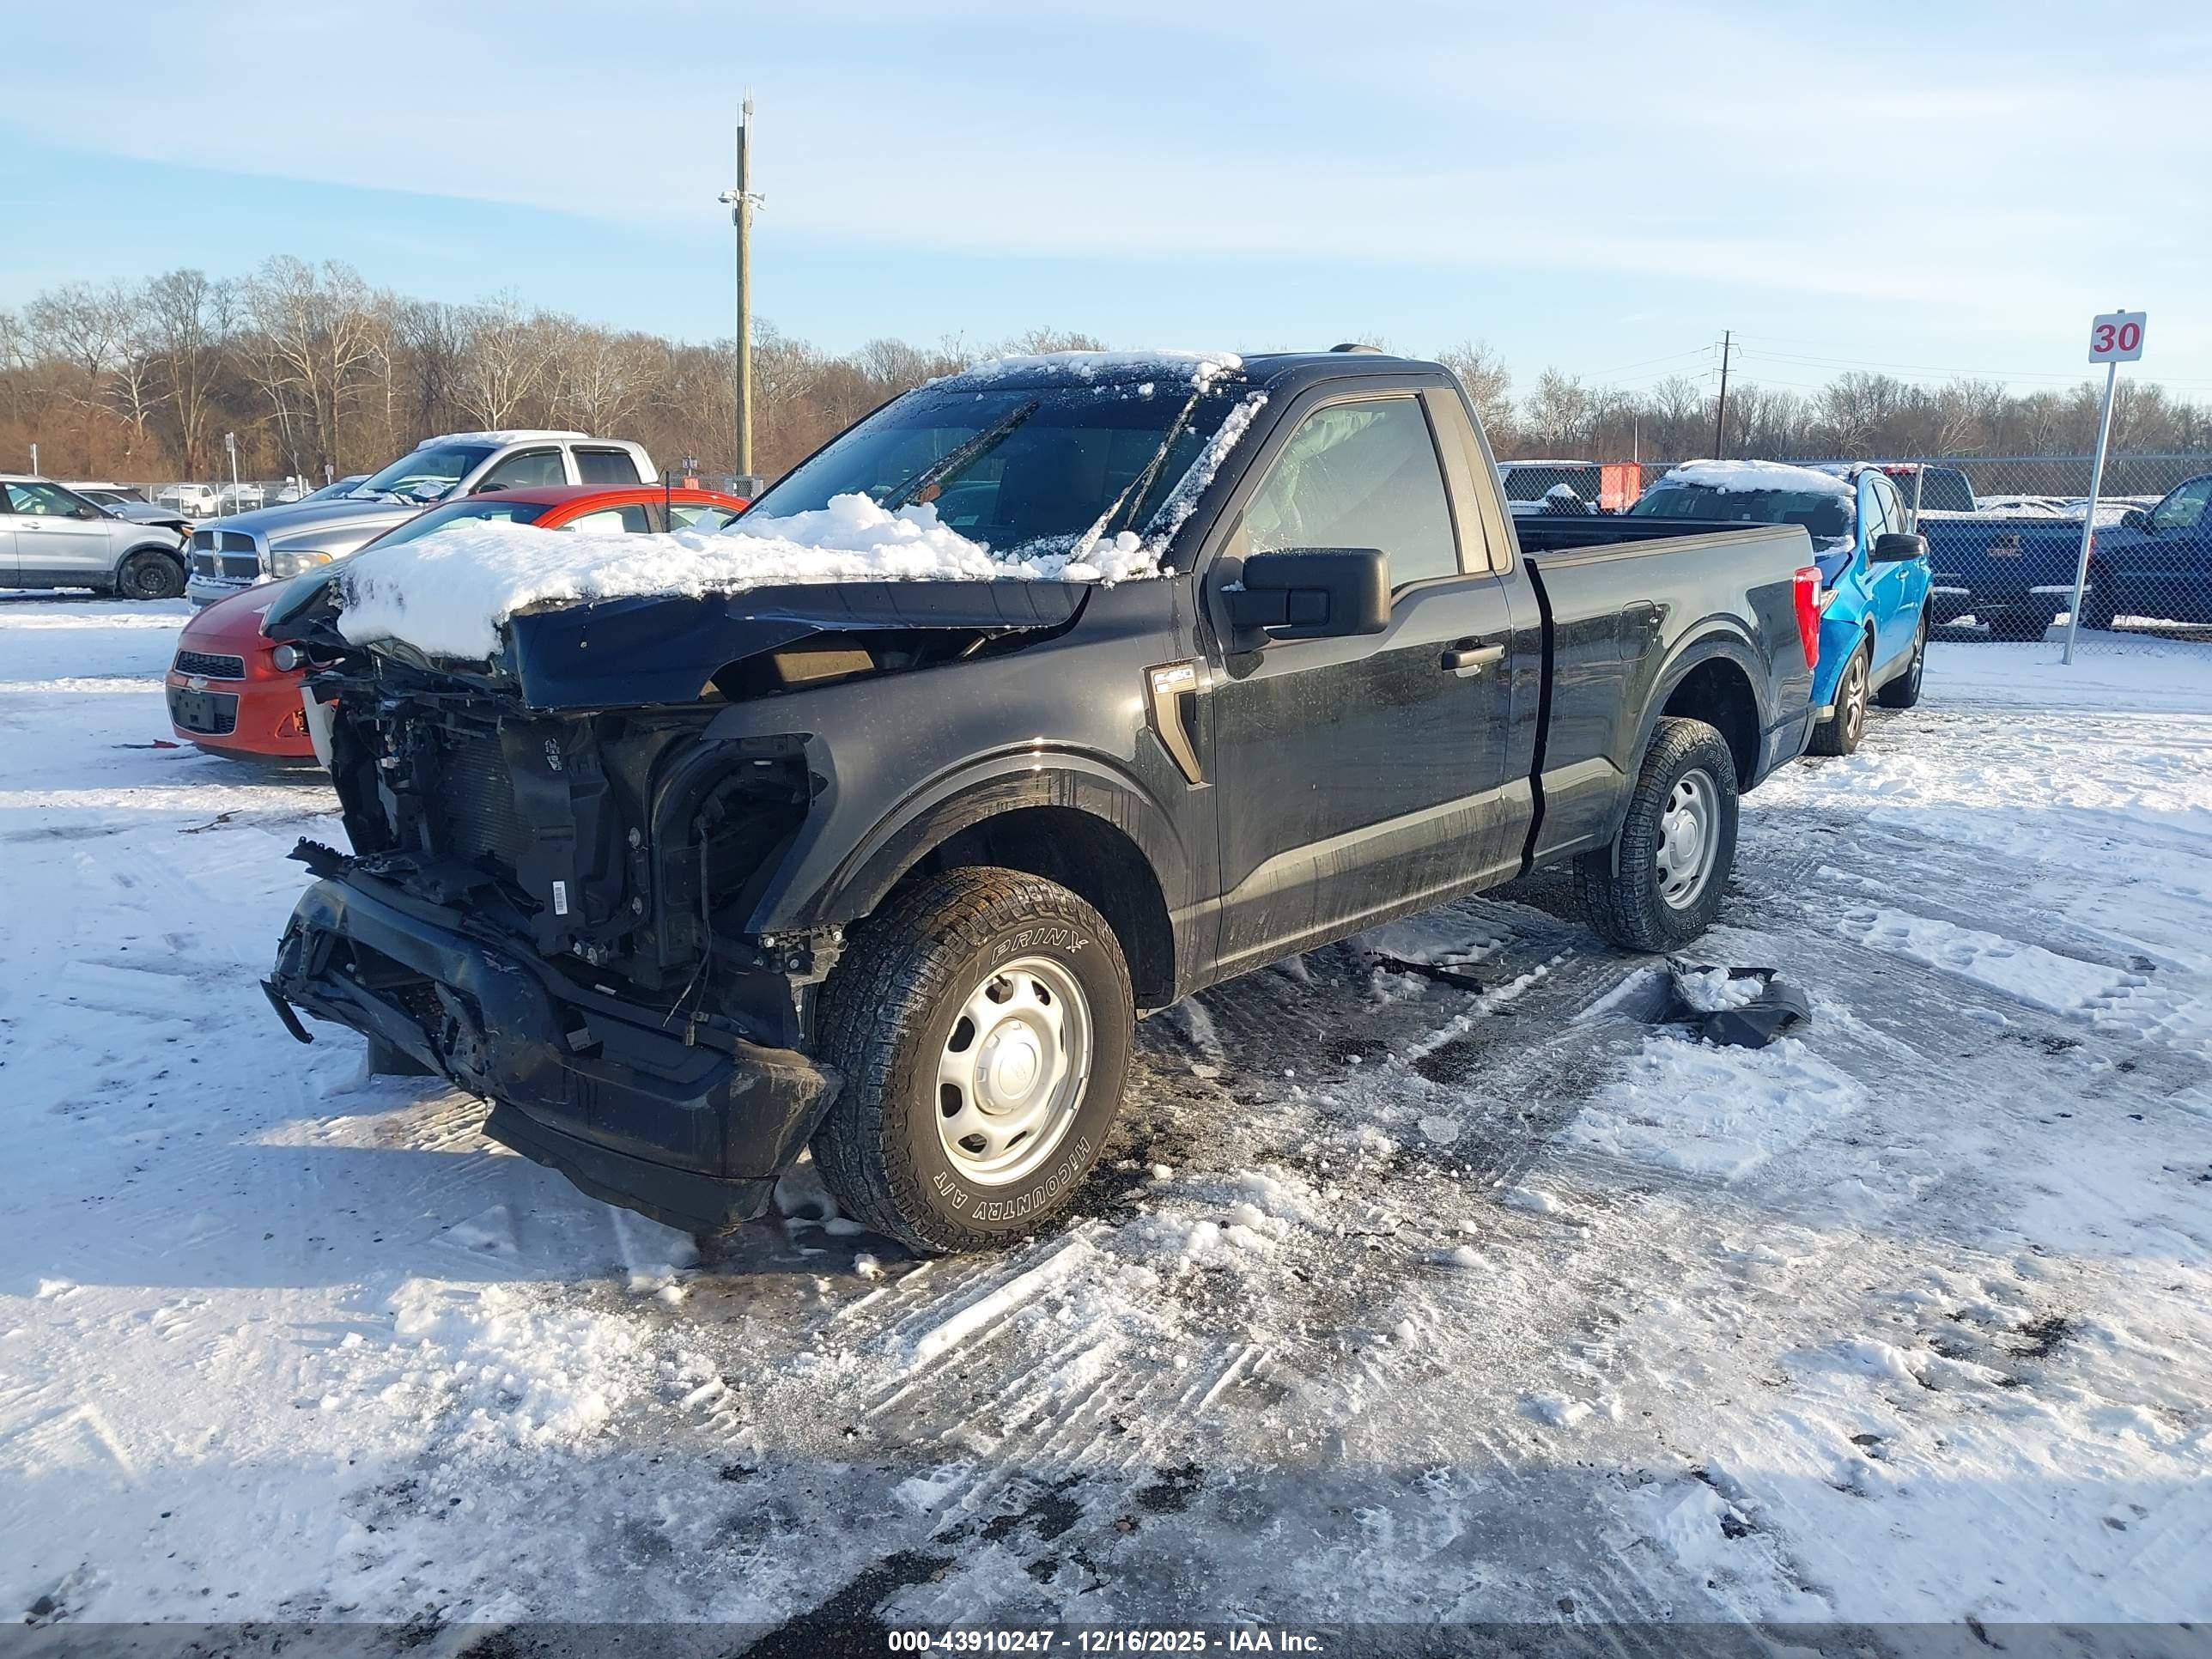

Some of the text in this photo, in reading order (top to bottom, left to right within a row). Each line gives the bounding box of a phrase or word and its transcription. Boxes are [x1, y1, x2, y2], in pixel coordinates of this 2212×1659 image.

[2094, 322, 2141, 353] 30
[1705, 750, 1736, 797] PRINX
[990, 927, 1090, 966] PRINX
[933, 1171, 969, 1210] A/T
